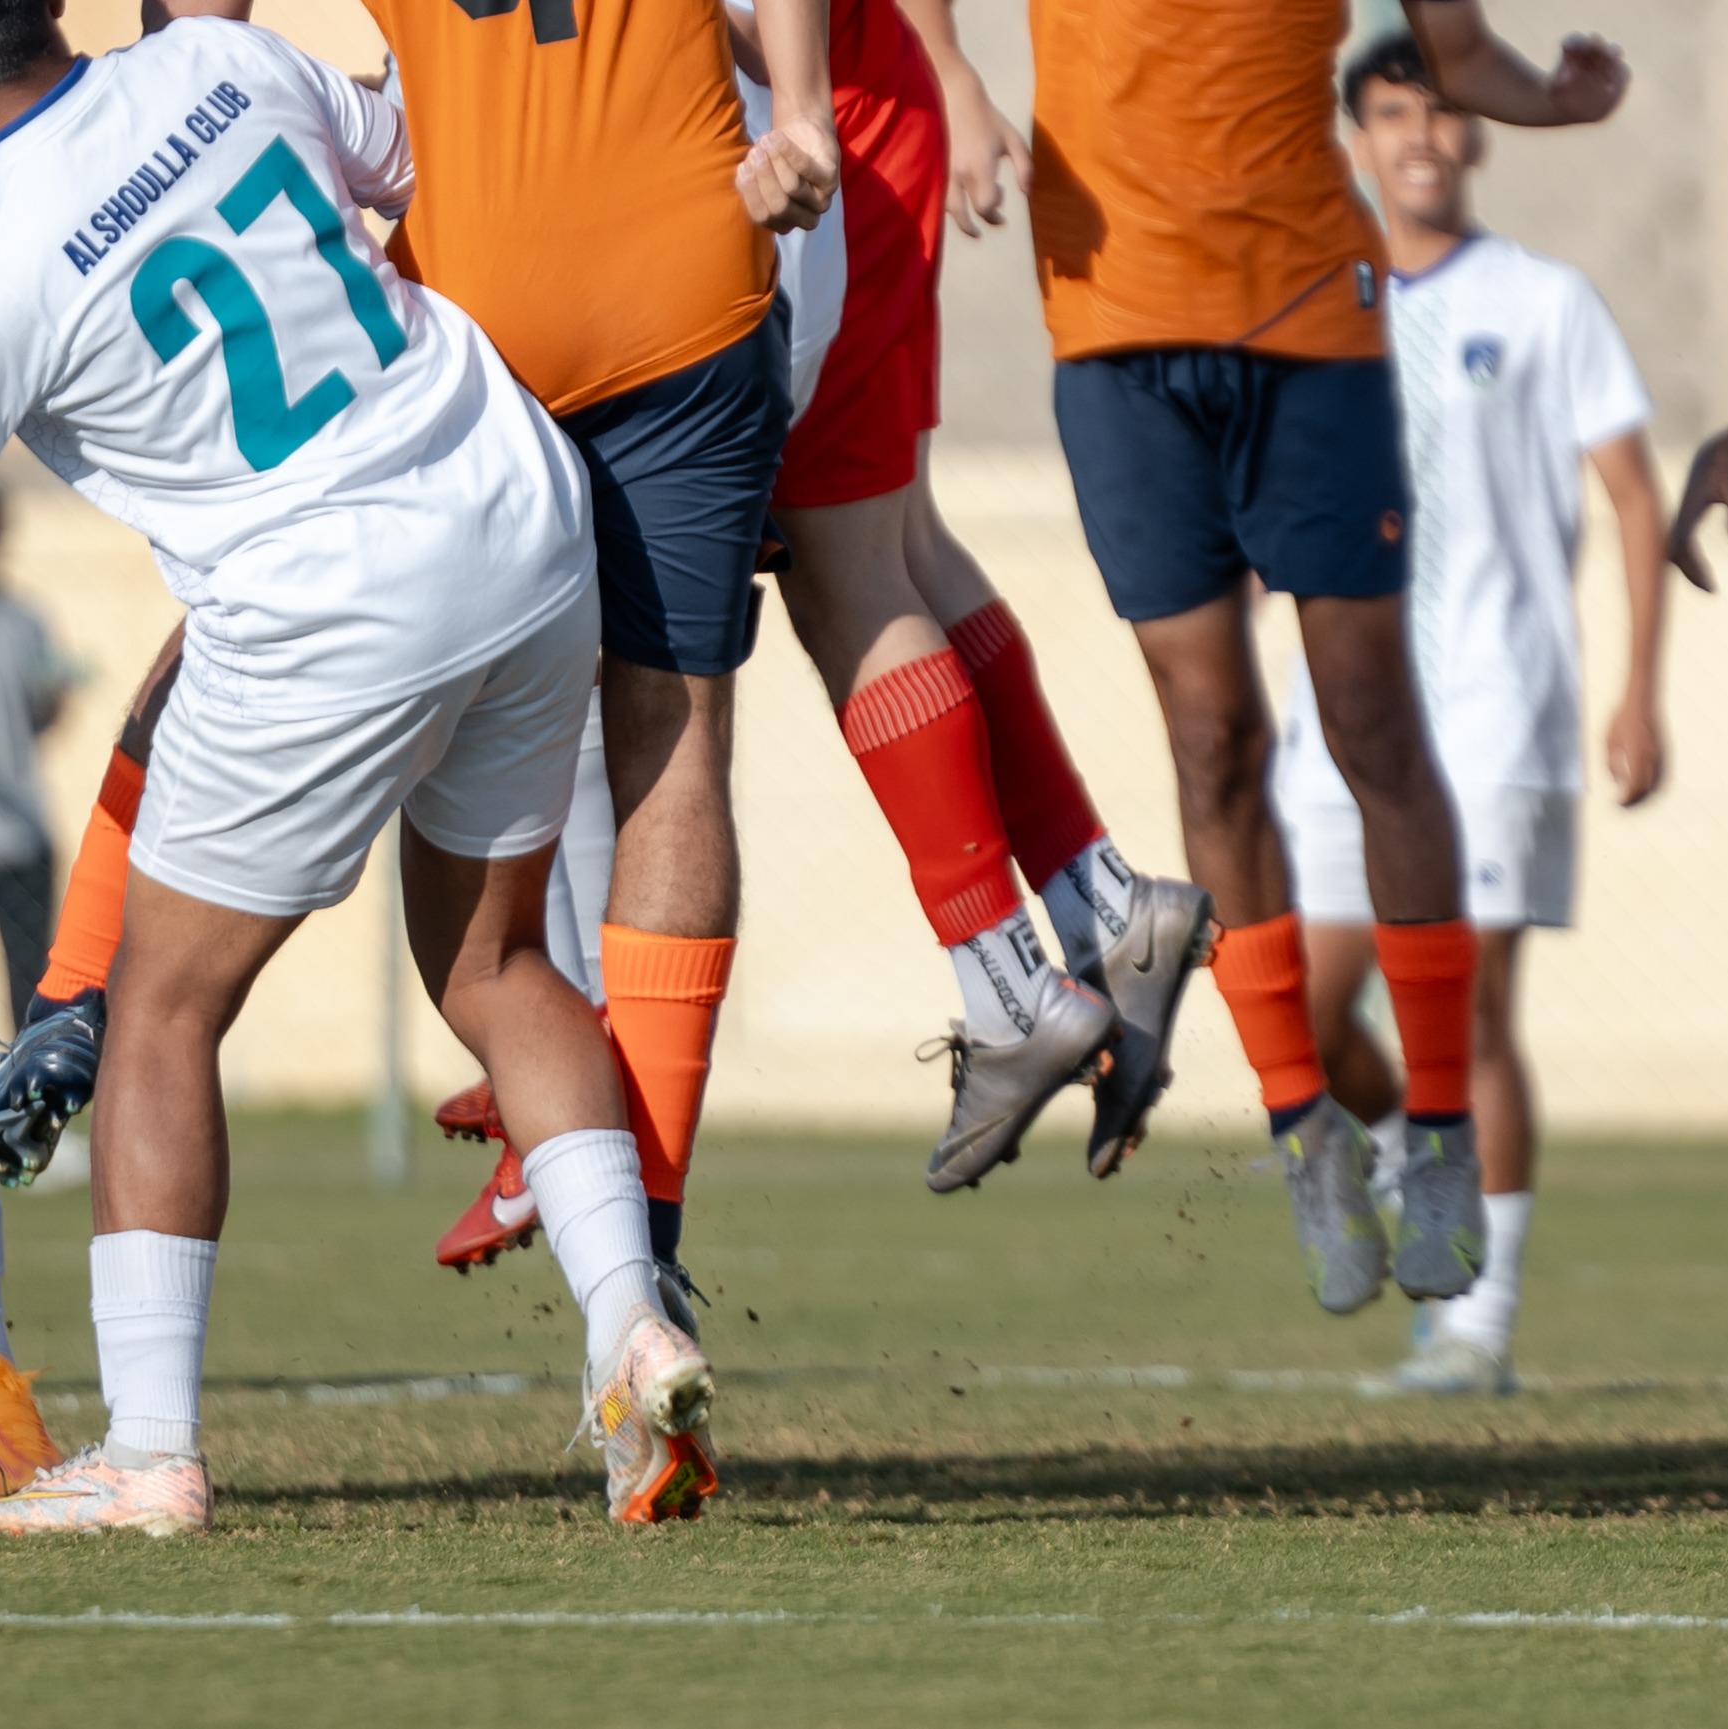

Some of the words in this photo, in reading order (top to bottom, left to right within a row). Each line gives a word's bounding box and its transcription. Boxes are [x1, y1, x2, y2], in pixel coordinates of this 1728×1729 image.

[62, 133, 201, 277] ALSHOULLA
[185, 80, 252, 145] CLUB
[130, 133, 408, 473] 27
